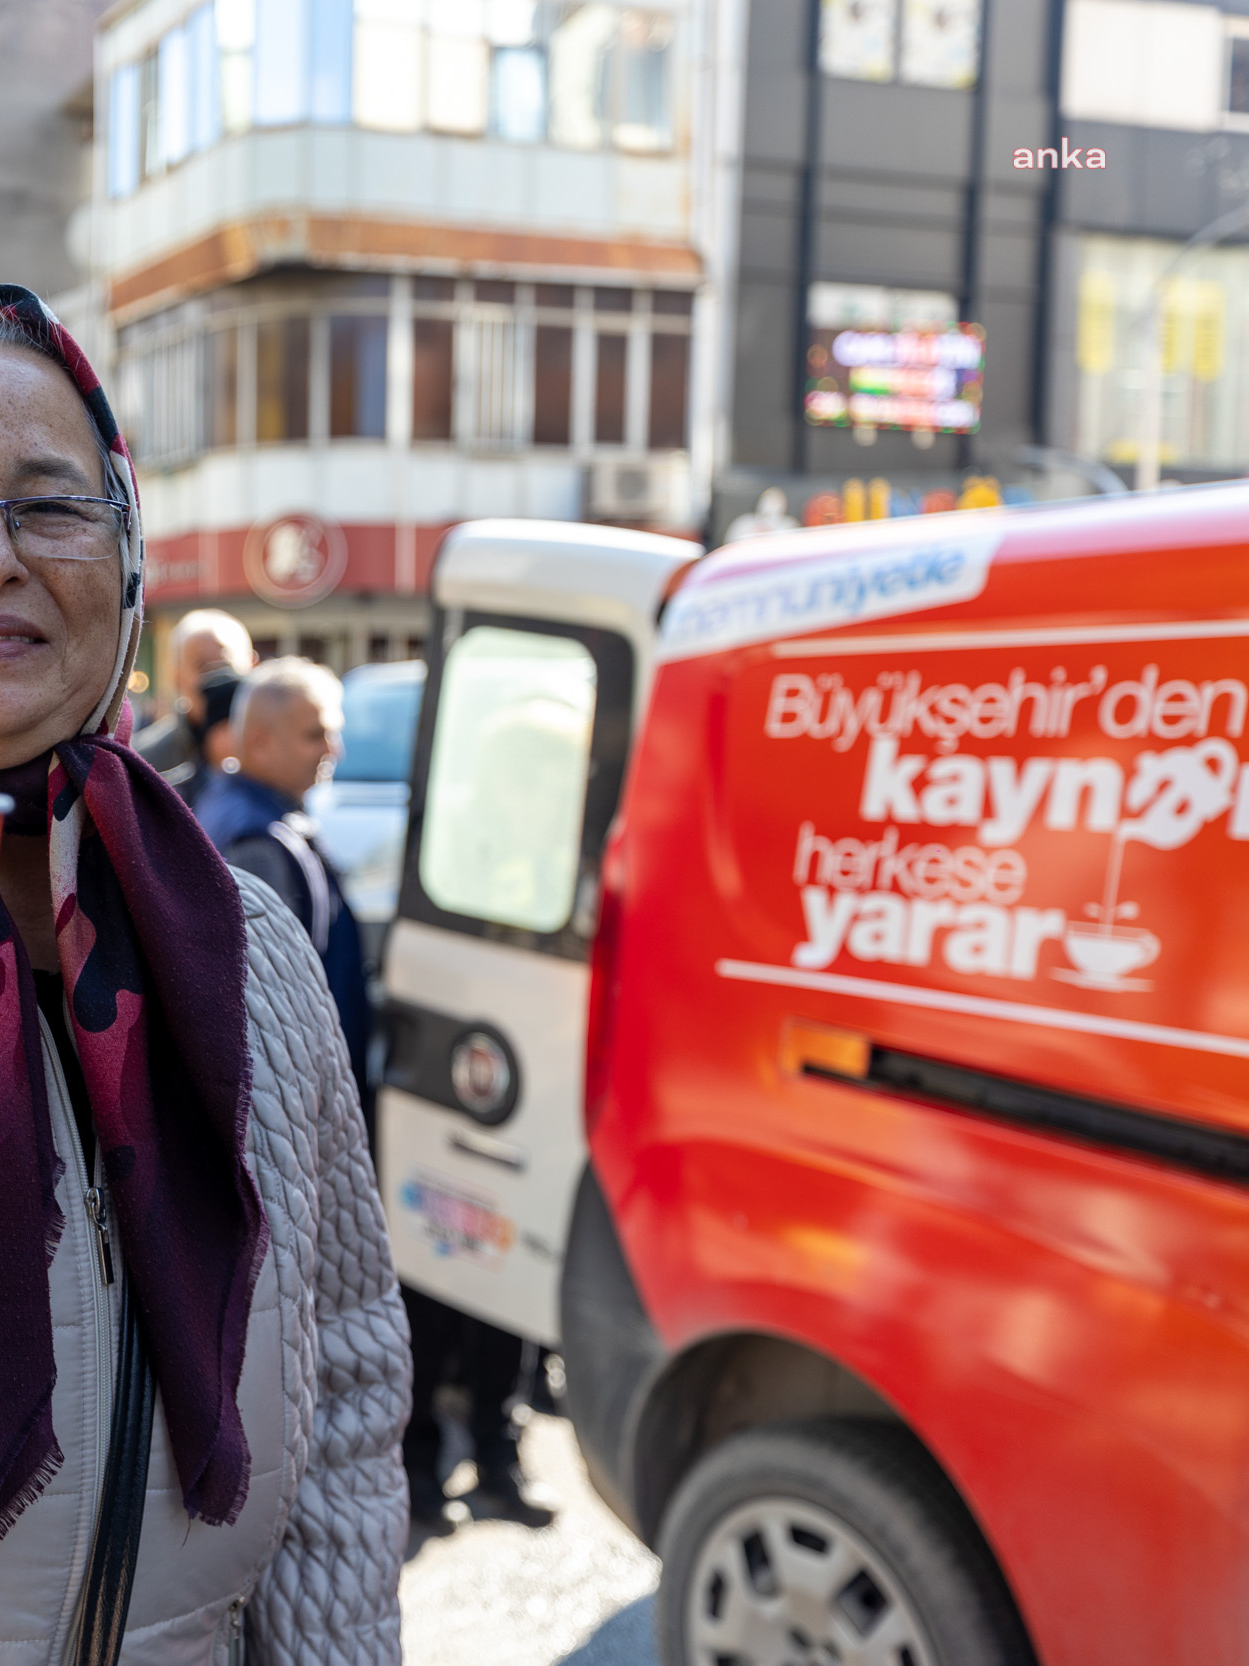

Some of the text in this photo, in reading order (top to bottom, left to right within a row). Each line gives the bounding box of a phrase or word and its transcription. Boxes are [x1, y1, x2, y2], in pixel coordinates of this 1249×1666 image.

[765, 664, 1249, 754] Büyükşehir'den
[794, 821, 1026, 904] herkese
[792, 885, 1065, 981] yarar
